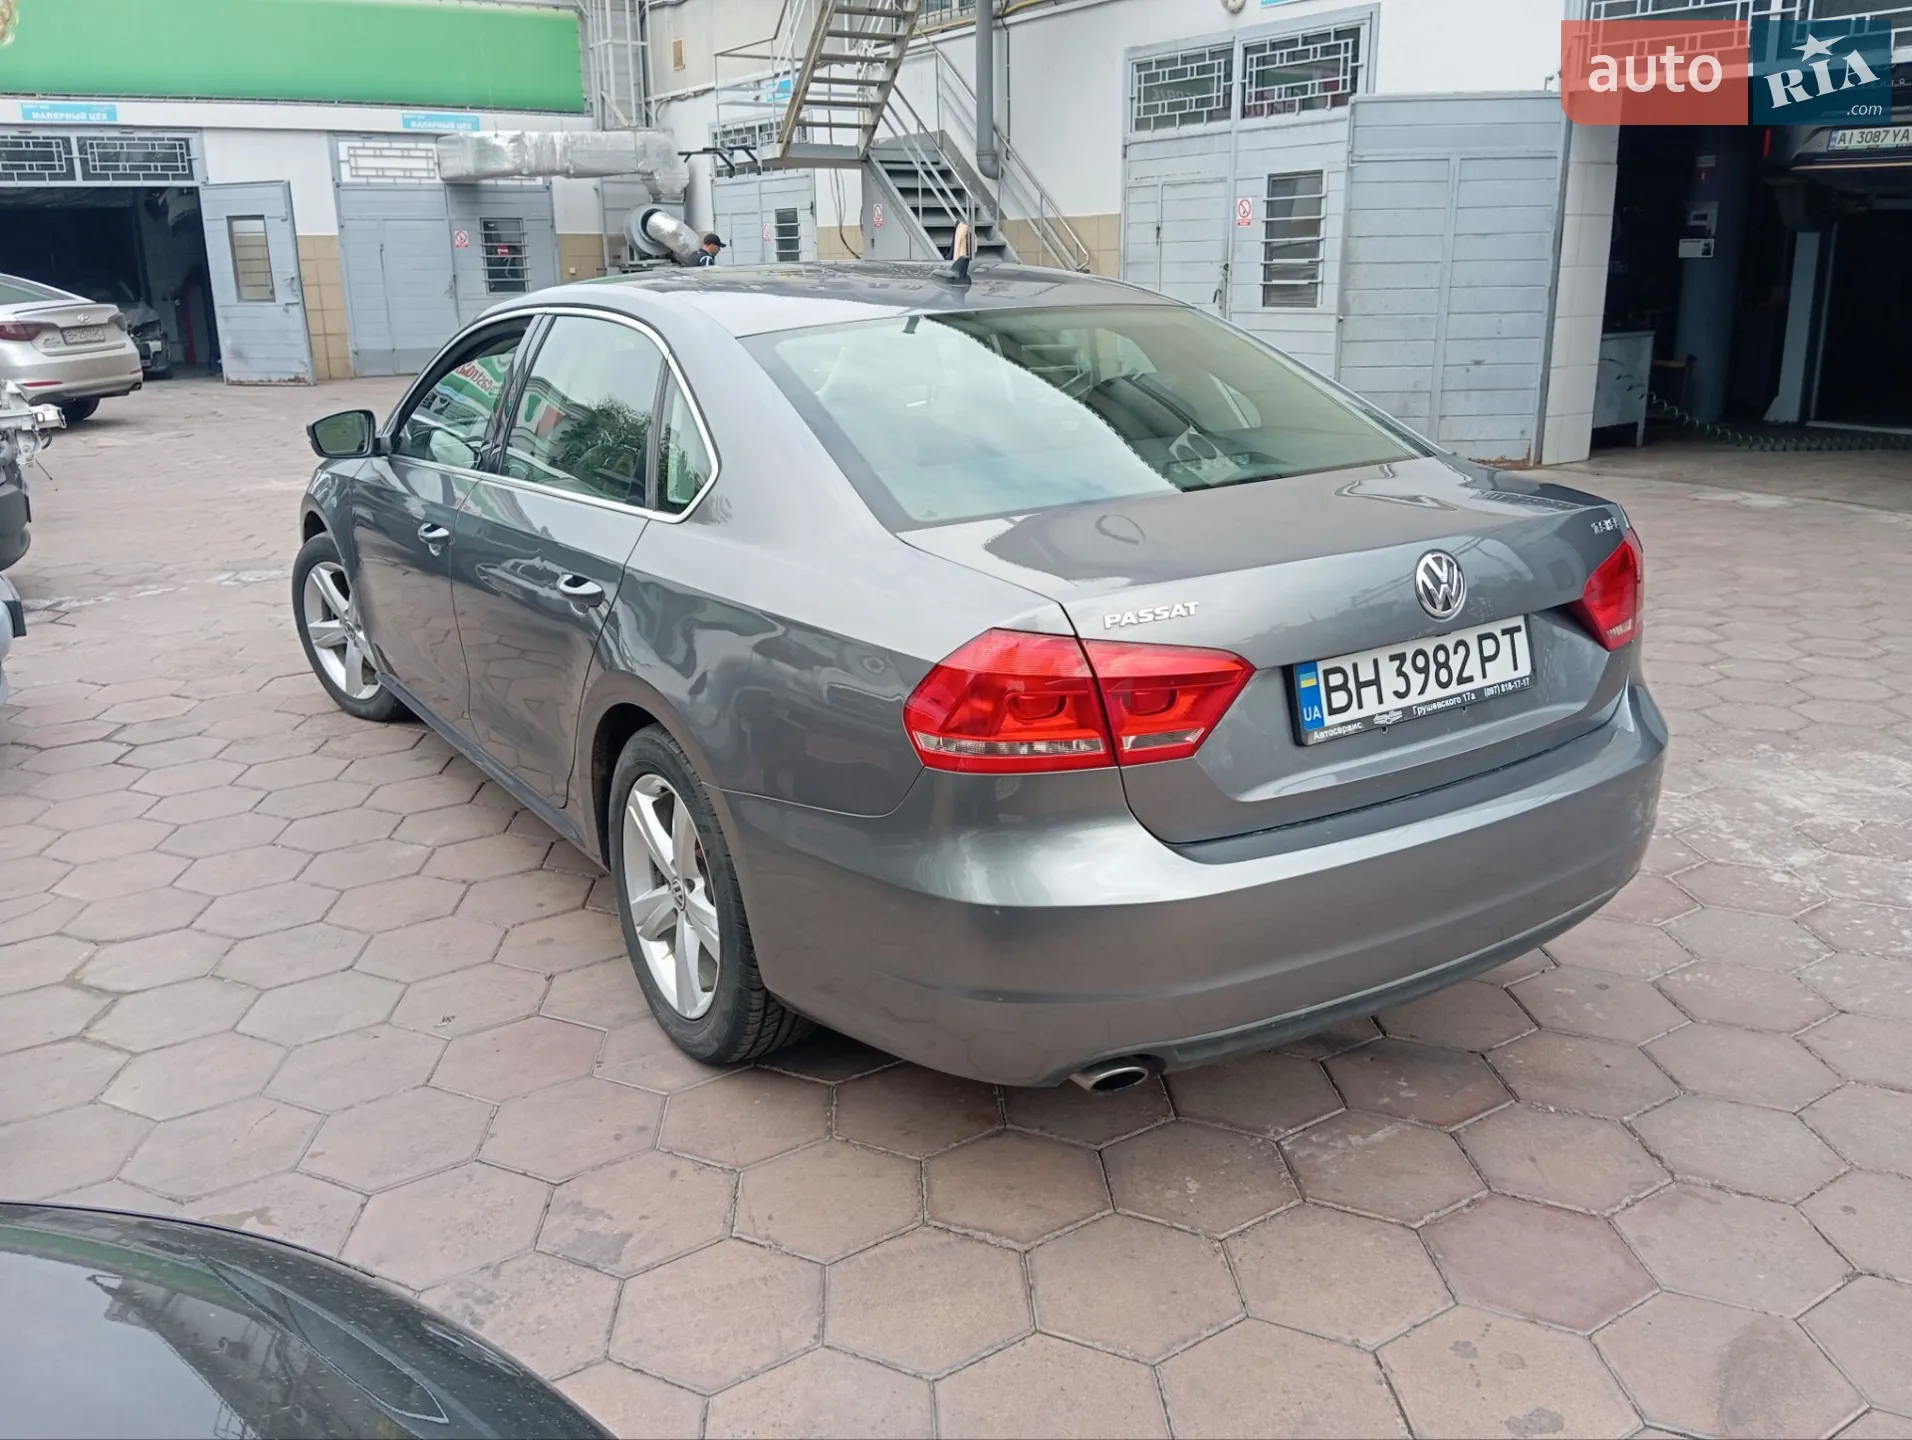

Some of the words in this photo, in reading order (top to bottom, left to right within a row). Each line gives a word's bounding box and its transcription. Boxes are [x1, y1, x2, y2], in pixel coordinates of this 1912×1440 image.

[1857, 130, 1890, 144] 3087
[1103, 601, 1200, 629] PASSAT
[1322, 658, 1384, 716] BH
[1388, 638, 1475, 700] 3982
[1476, 624, 1523, 679] PT
[1412, 696, 1462, 716] Грушевского
[1484, 684, 1501, 698] (097)
[1303, 706, 1322, 722] UA
[1313, 721, 1363, 741] Автосервис
